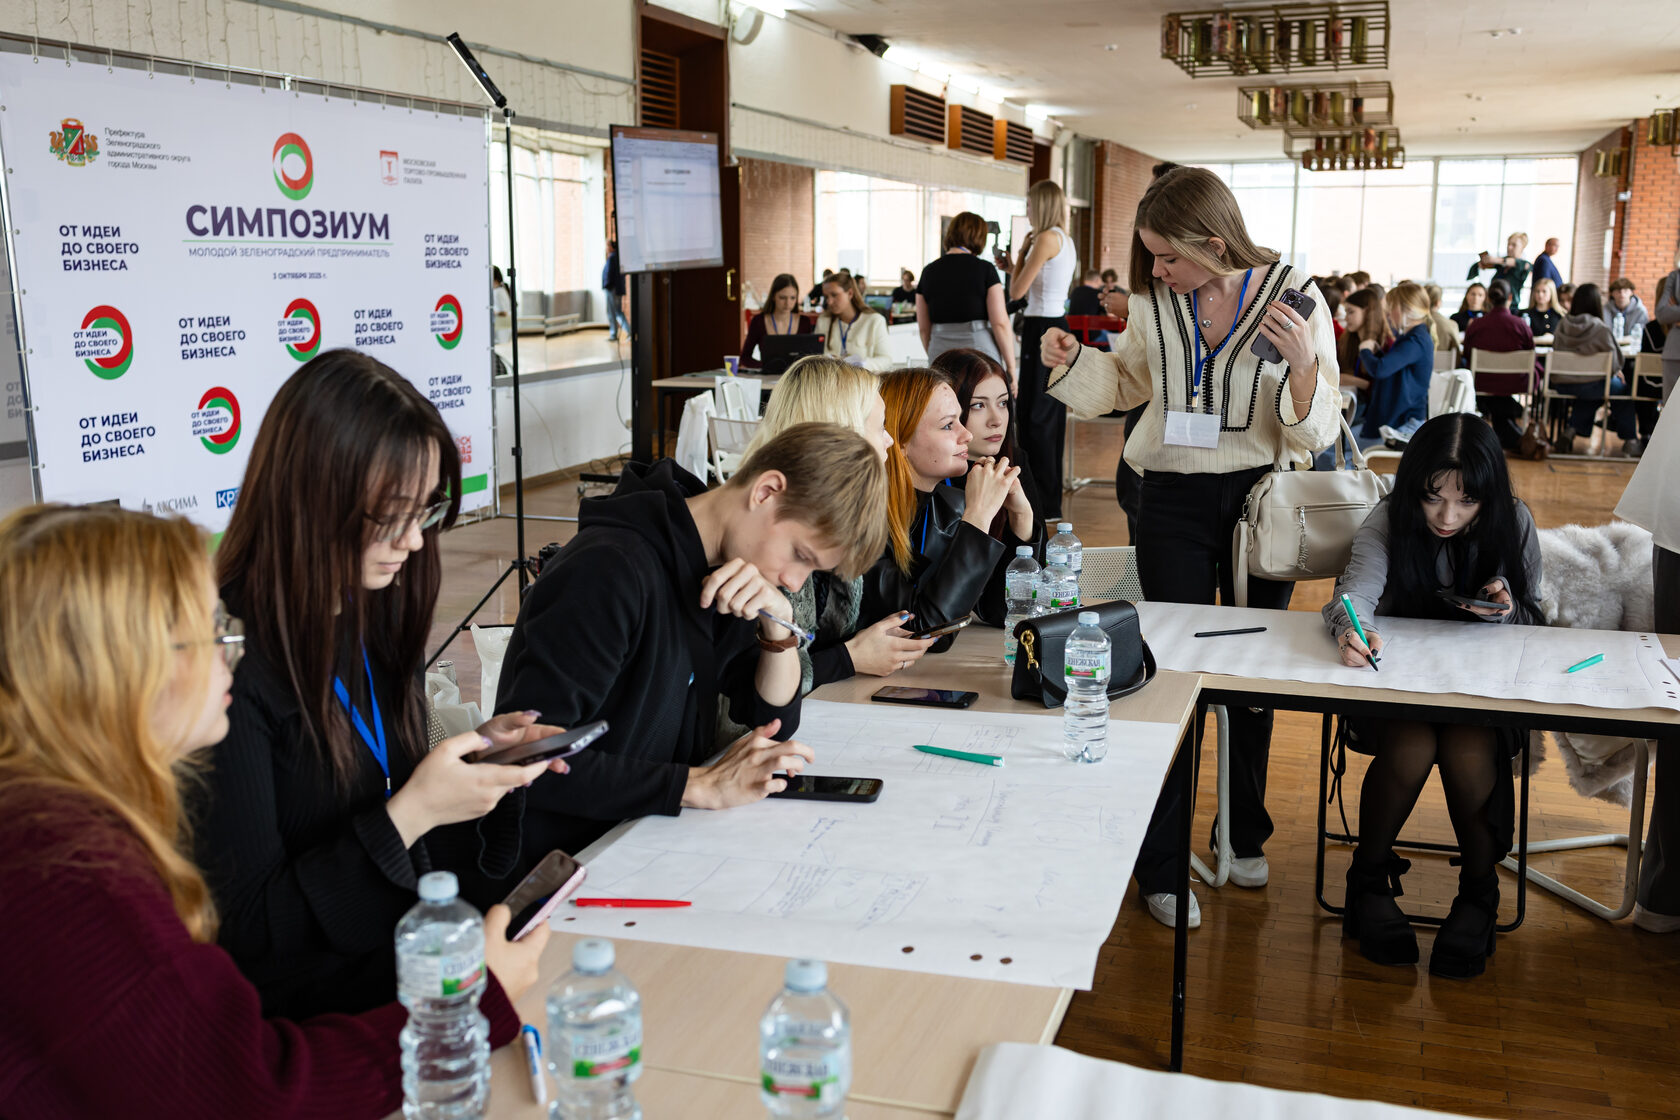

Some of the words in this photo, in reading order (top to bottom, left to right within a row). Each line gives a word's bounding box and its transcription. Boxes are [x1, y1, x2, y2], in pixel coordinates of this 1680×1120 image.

[104, 127, 145, 138] Префектура
[105, 138, 161, 150] Зеленоградского
[107, 150, 169, 161] административного
[170, 154, 191, 163] округа
[107, 161, 130, 169] города
[132, 161, 157, 170] Москвы
[186, 204, 390, 240] СИМПОЗИУМ
[59, 225, 78, 237] ОТ
[82, 225, 121, 239] ИДЕИ
[424, 234, 434, 243] ОТ
[437, 234, 459, 244] ИДЕИ
[61, 242, 82, 256] ДО
[86, 242, 139, 254] СВОЕГО
[189, 246, 237, 258] МОЛОДОЙ
[239, 247, 316, 258] ЗЕЛЕНОГРАДСКИЙ
[316, 248, 390, 258] ПРЕДПРИНИМАТЕЛЬ
[425, 247, 437, 256] ДО
[439, 247, 469, 256] СВОЕГО
[63, 259, 128, 271] БИЗНЕСА
[425, 260, 462, 268] БИЗНЕСА
[278, 272, 307, 280] ОКТЯБРЯ
[354, 310, 365, 319] ОТ
[368, 309, 392, 319] ИДЕИ
[179, 318, 194, 328] ОТ
[198, 316, 230, 328] ИДЕИ
[354, 323, 368, 334] ДО
[370, 321, 403, 332] СВОЕГО
[73, 331, 83, 339] ОТ
[180, 333, 197, 346] ДО
[201, 330, 246, 343] СВОЕГО
[355, 335, 396, 346] БИЗНЕСА
[75, 341, 86, 349] ДО
[88, 339, 118, 347] СВОЕГО
[75, 349, 111, 357] БИЗНЕСА
[181, 346, 236, 360] БИЗНЕСА
[429, 377, 438, 386] ОТ
[441, 375, 462, 384] ИДЕИ
[429, 389, 440, 399] ДО
[443, 385, 471, 397] СВОЕГО
[79, 417, 97, 429] ОТ
[101, 412, 138, 427] ИДЕИ
[192, 420, 201, 428] ДО
[203, 417, 228, 425] СВОЕГО
[192, 426, 222, 435] БИЗНЕСА
[81, 433, 101, 448] ДО
[105, 426, 155, 442] СВОЕГО
[83, 444, 145, 462] БИЗНЕСА
